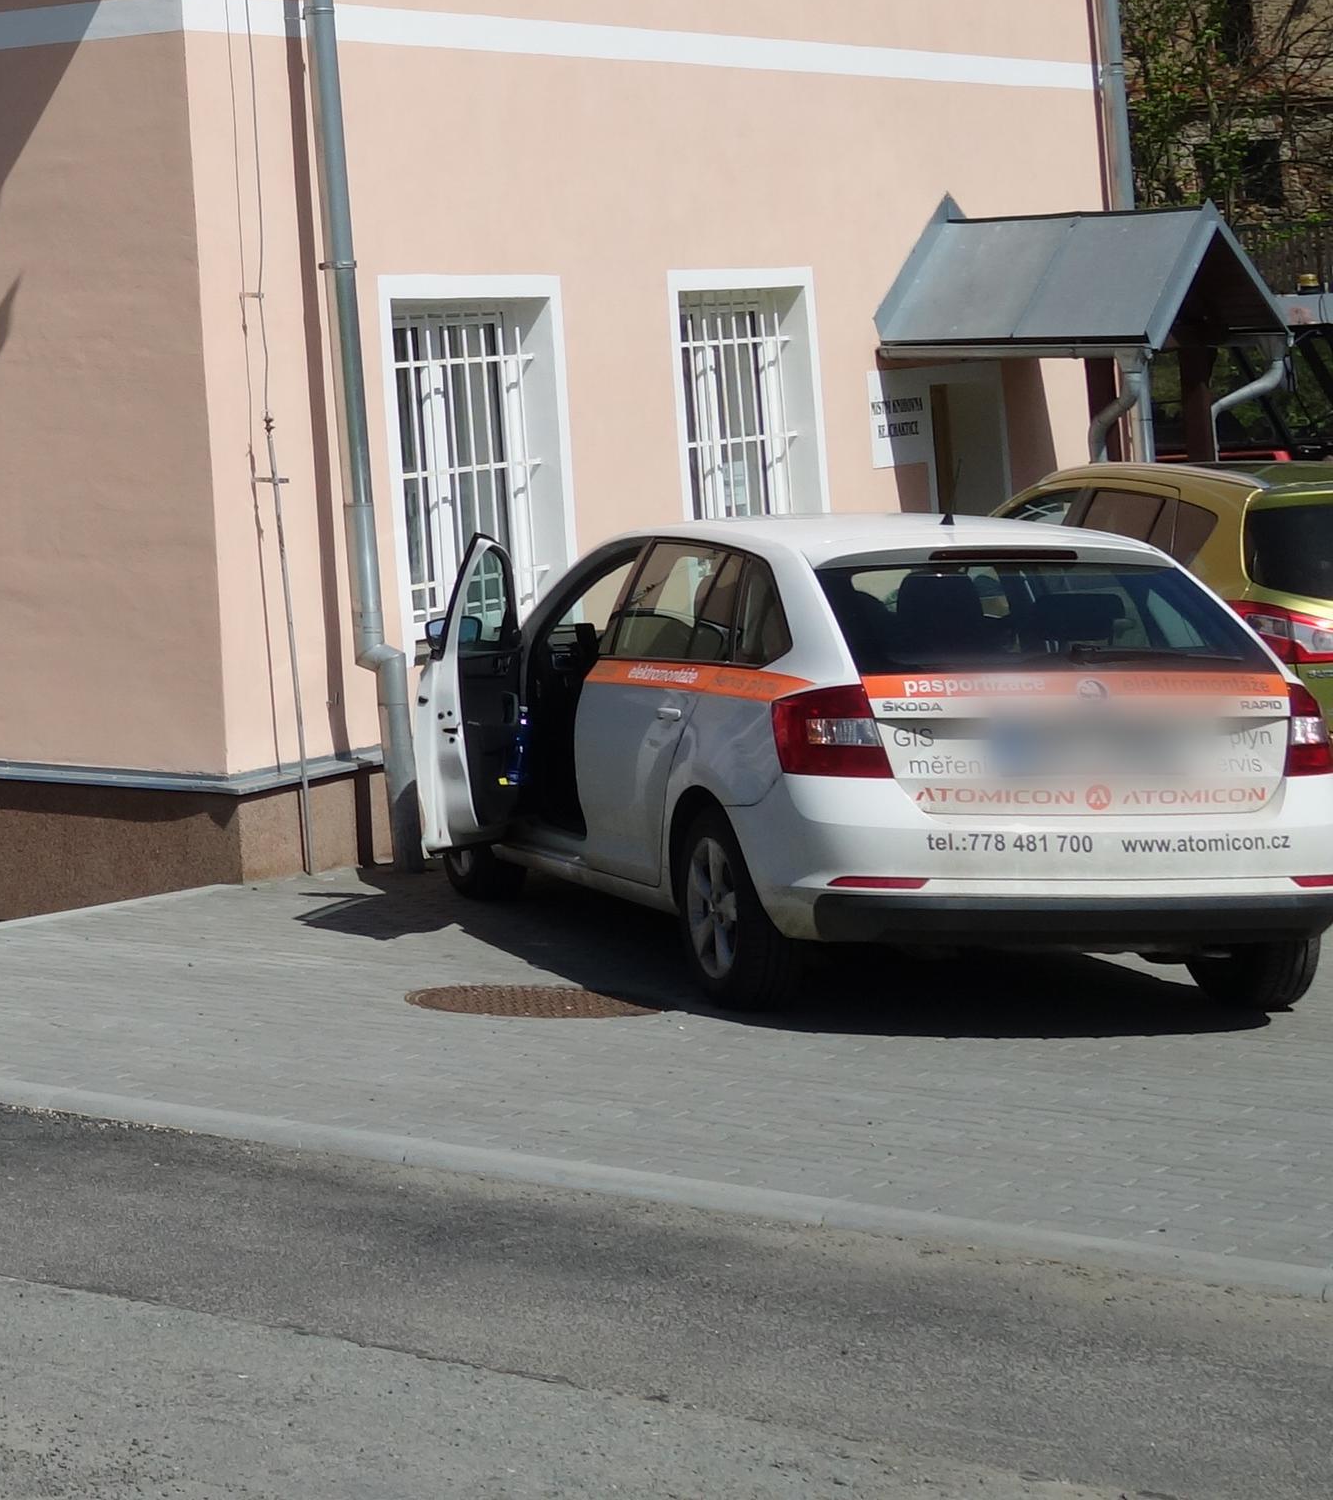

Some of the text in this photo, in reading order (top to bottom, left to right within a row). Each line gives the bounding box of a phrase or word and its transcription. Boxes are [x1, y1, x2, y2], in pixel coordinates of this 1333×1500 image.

[882, 701, 943, 712] ŠKODA
[1240, 700, 1282, 710] RAPID
[893, 728, 935, 747] GIS
[915, 787, 1075, 805] ATOMICON
[1123, 787, 1266, 805] ATOMICON
[927, 833, 1093, 853] tel.:778 481 700
[1121, 834, 1291, 853] www.atomicon.cz
